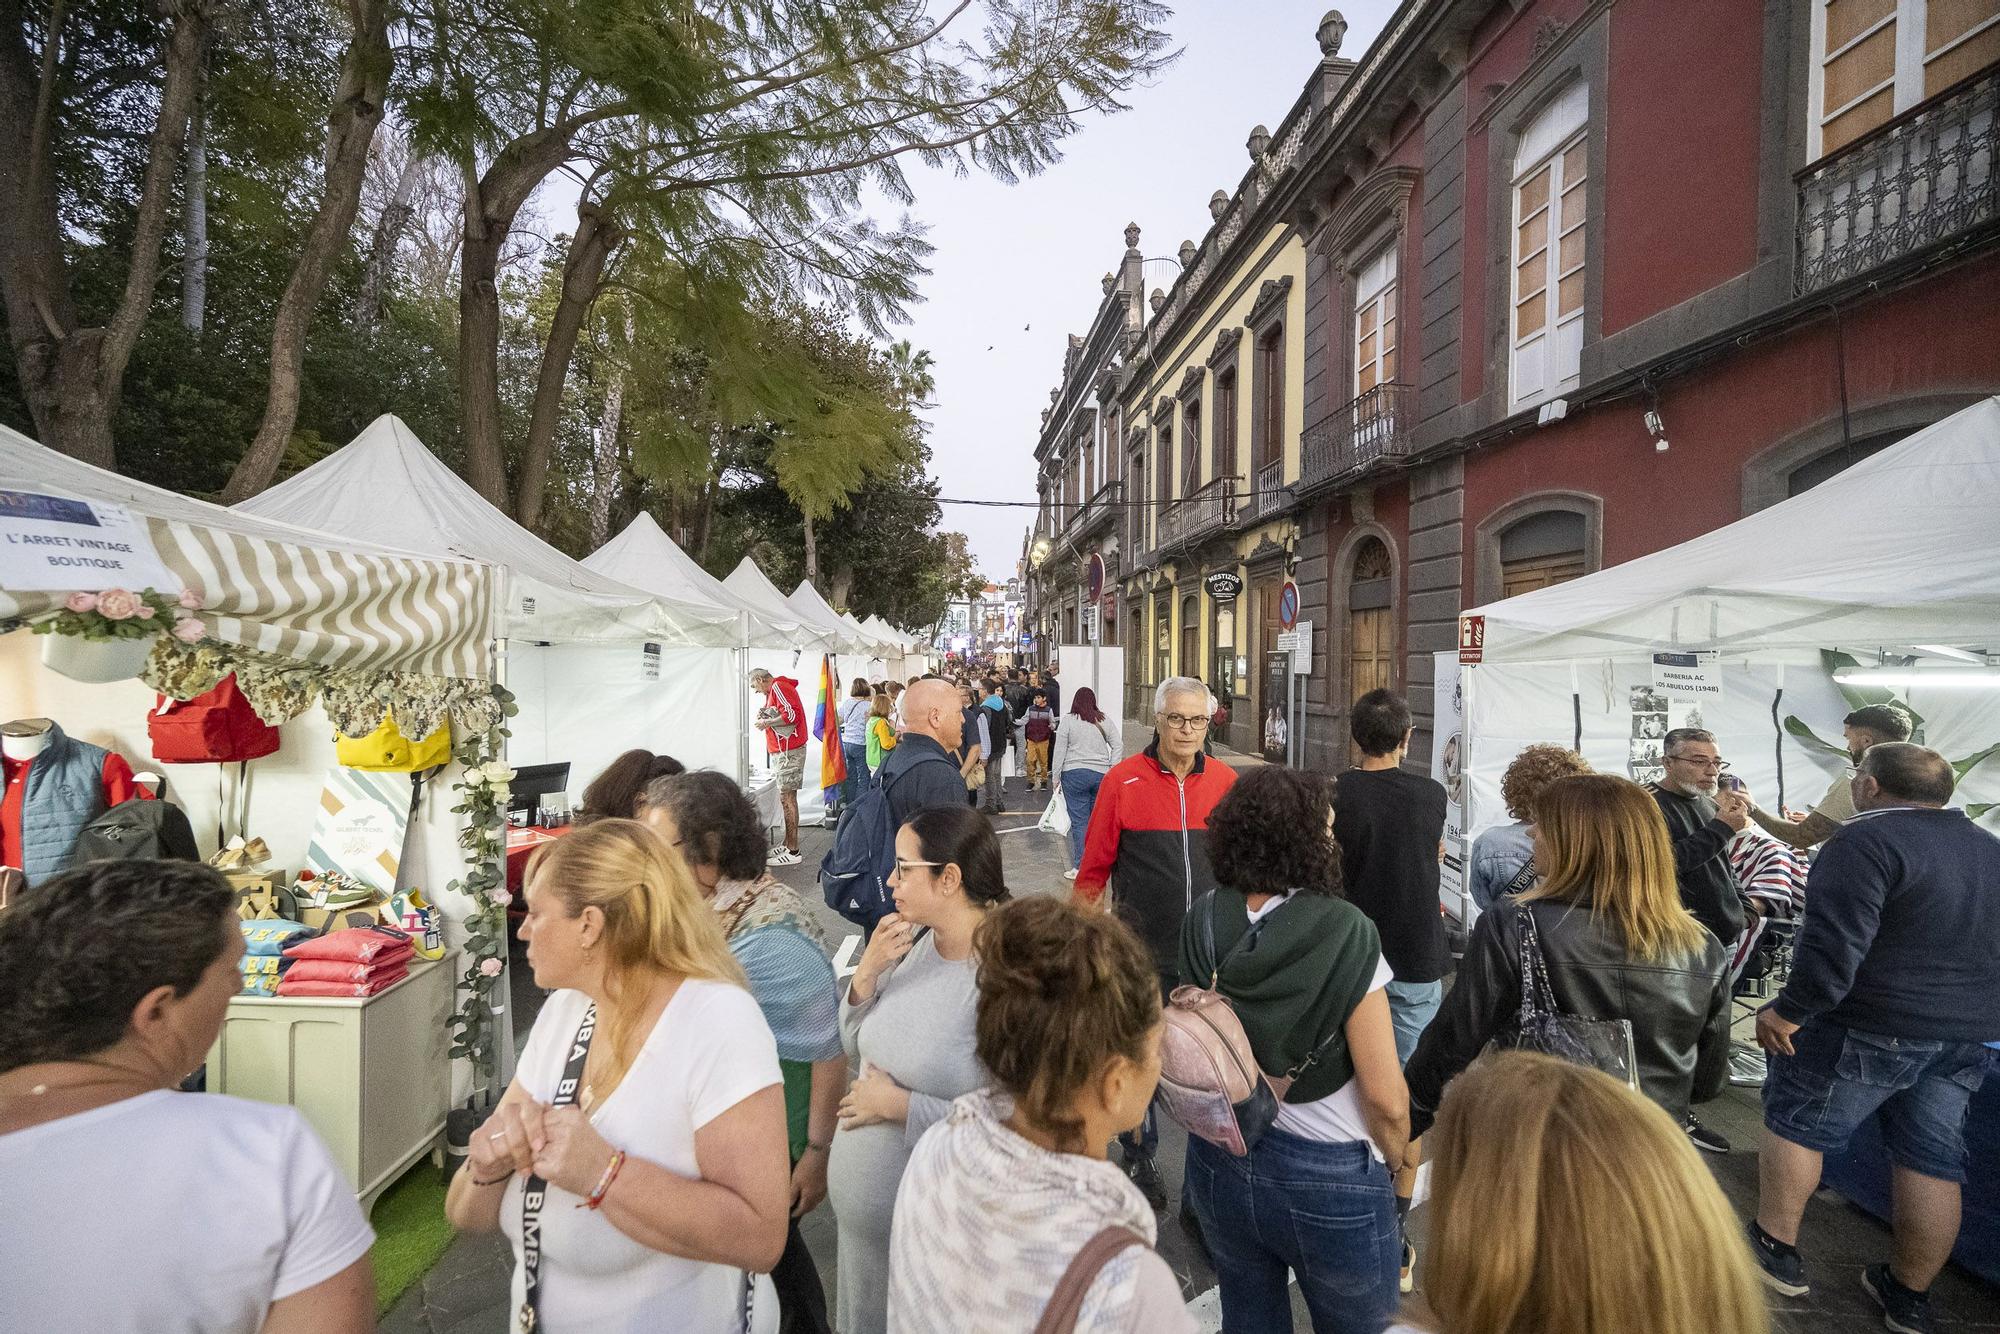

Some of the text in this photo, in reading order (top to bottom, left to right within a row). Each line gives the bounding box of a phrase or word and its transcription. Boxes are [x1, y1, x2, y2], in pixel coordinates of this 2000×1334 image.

[74, 538, 134, 553] VINTAGE
[47, 555, 125, 570] BOUTIQUE
[1208, 573, 1241, 583] MESTIZOS
[1663, 672, 1693, 681] BARBERIA
[1666, 683, 1694, 691] ABUELOS
[1695, 685, 1719, 693] (1948)
[523, 1191, 544, 1290] BIMBA
